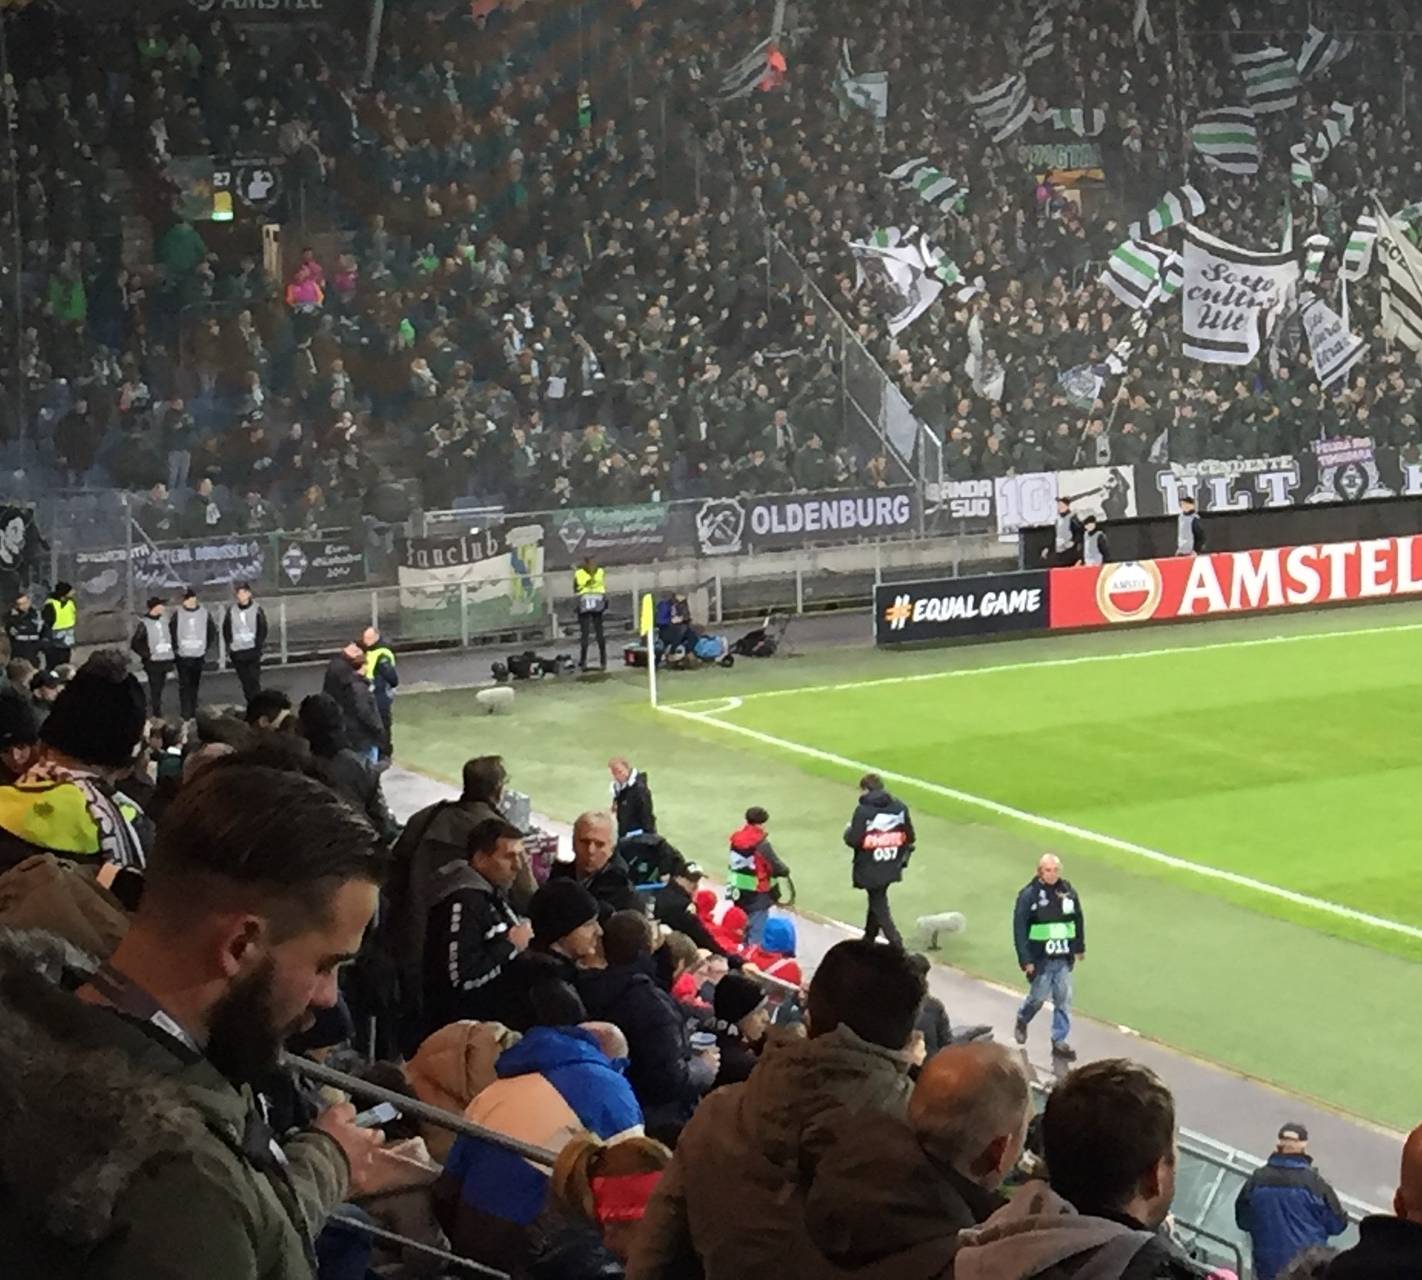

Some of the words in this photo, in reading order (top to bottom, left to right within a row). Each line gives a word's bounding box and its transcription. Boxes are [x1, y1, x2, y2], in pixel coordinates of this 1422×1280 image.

[213, 172, 231, 186] 27
[751, 495, 911, 535] OLDENBURG
[873, 846, 898, 862] 037
[1045, 938, 1070, 954] 011
